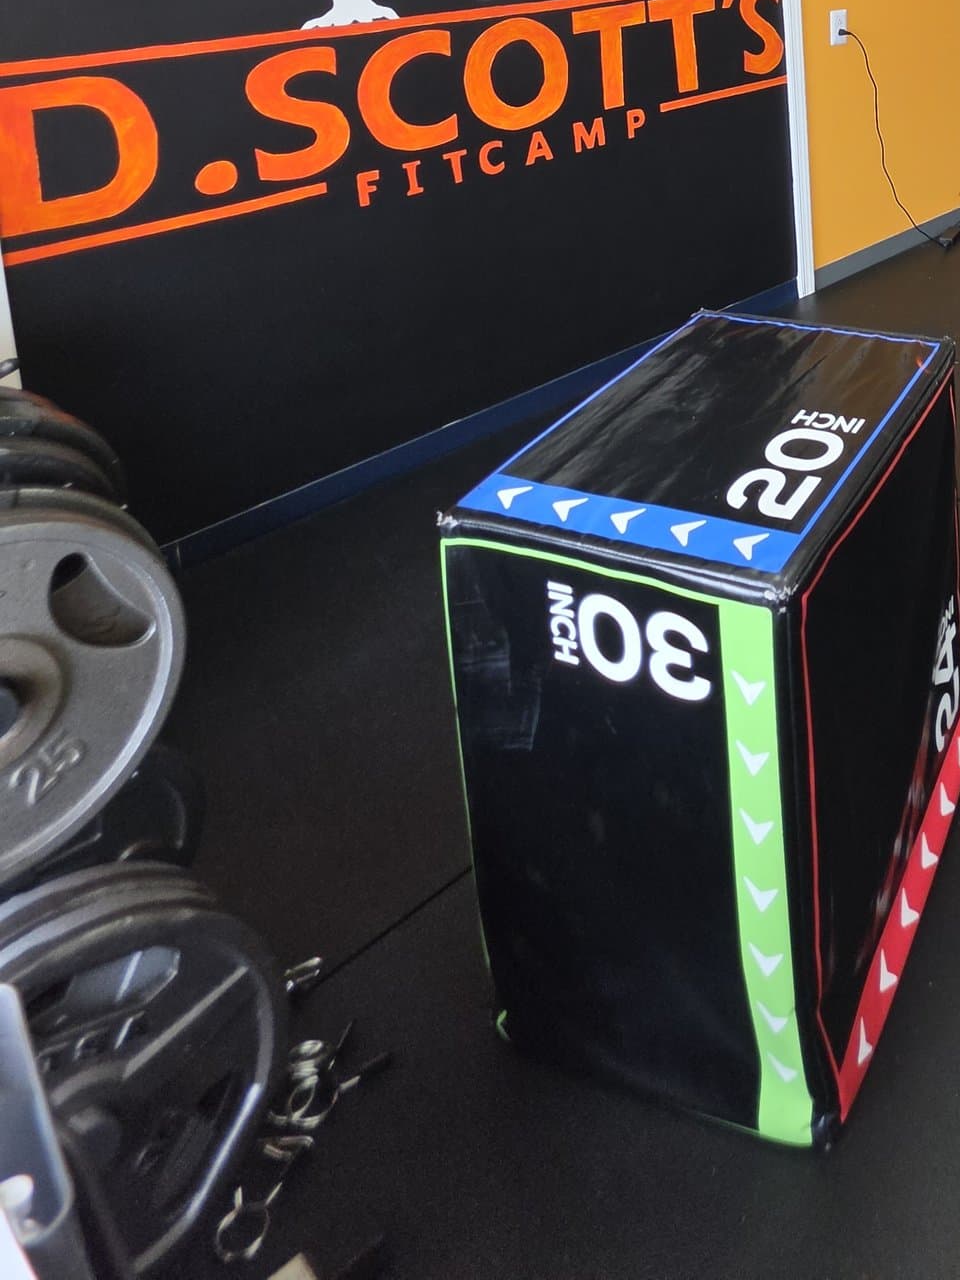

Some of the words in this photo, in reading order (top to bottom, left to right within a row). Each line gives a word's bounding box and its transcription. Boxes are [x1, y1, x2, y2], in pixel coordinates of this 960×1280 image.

[357, 110, 646, 208] FITCAMP
[790, 409, 866, 434] INCH
[726, 427, 844, 520] 20
[547, 580, 580, 665] INCH
[578, 593, 712, 701] 30
[933, 621, 960, 753] 24
[8, 732, 87, 807] 25
